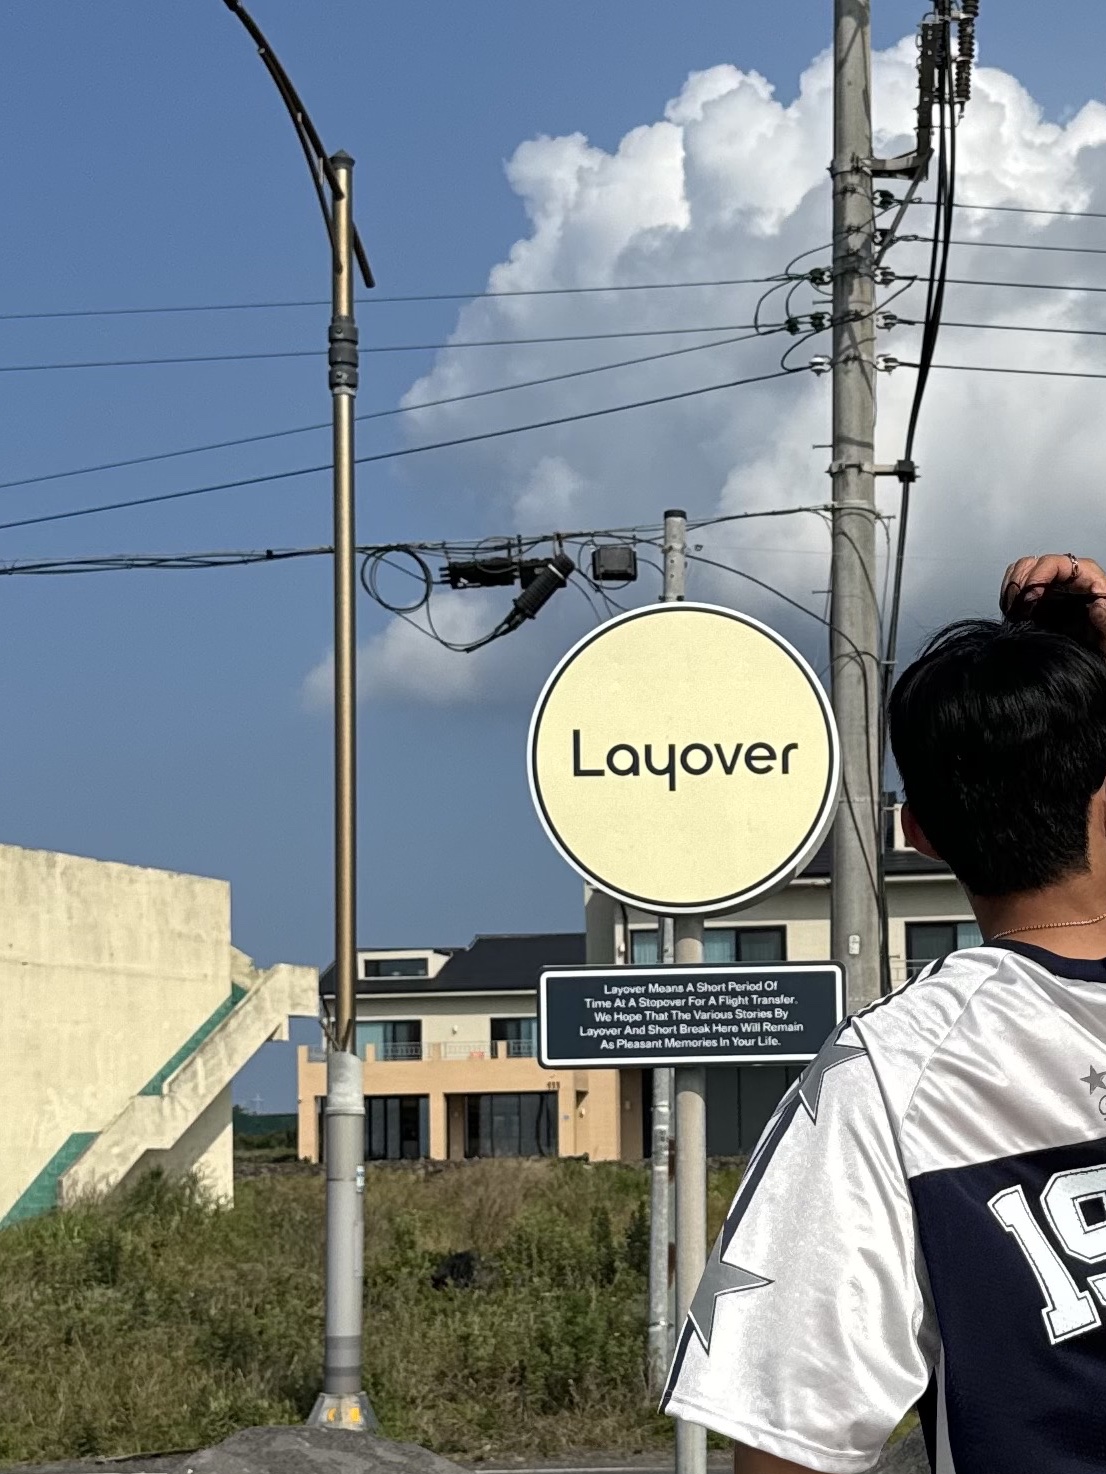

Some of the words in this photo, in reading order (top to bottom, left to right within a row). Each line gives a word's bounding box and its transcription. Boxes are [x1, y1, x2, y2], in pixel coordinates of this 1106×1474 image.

[573, 729, 798, 791] Layover
[603, 984, 646, 996] Layover
[648, 983, 684, 993] Means
[685, 982, 695, 992] A
[696, 982, 726, 992] Short
[728, 981, 763, 991] Period
[764, 980, 778, 991] Of
[584, 998, 612, 1008] Time
[613, 998, 626, 1008] At
[628, 997, 637, 1008] A
[638, 997, 687, 1008] Stopover
[688, 996, 706, 1006] For
[708, 996, 717, 1006] A
[718, 995, 749, 1007] Flight
[750, 994, 798, 1005] Transfer.
[594, 1012, 612, 1022] We
[613, 1012, 642, 1023] Hope
[644, 1011, 669, 1021] That
[670, 1010, 692, 1020] The
[693, 1009, 733, 1020] Various
[735, 1008, 773, 1019] Stories
[774, 1008, 789, 1020] By
[580, 1026, 622, 1038] Layover
[624, 1025, 646, 1035] And
[647, 1024, 677, 1034] Short
[679, 1023, 711, 1034] Break
[712, 1023, 739, 1033] Here
[740, 1022, 761, 1032] Will
[762, 1021, 804, 1032] Remain
[600, 1040, 615, 1050] As
[616, 1039, 663, 1049] Pleasant
[664, 1037, 718, 1048] Memories
[719, 1037, 730, 1046] In
[731, 1036, 756, 1046] Your
[757, 1035, 782, 1046] Life.
